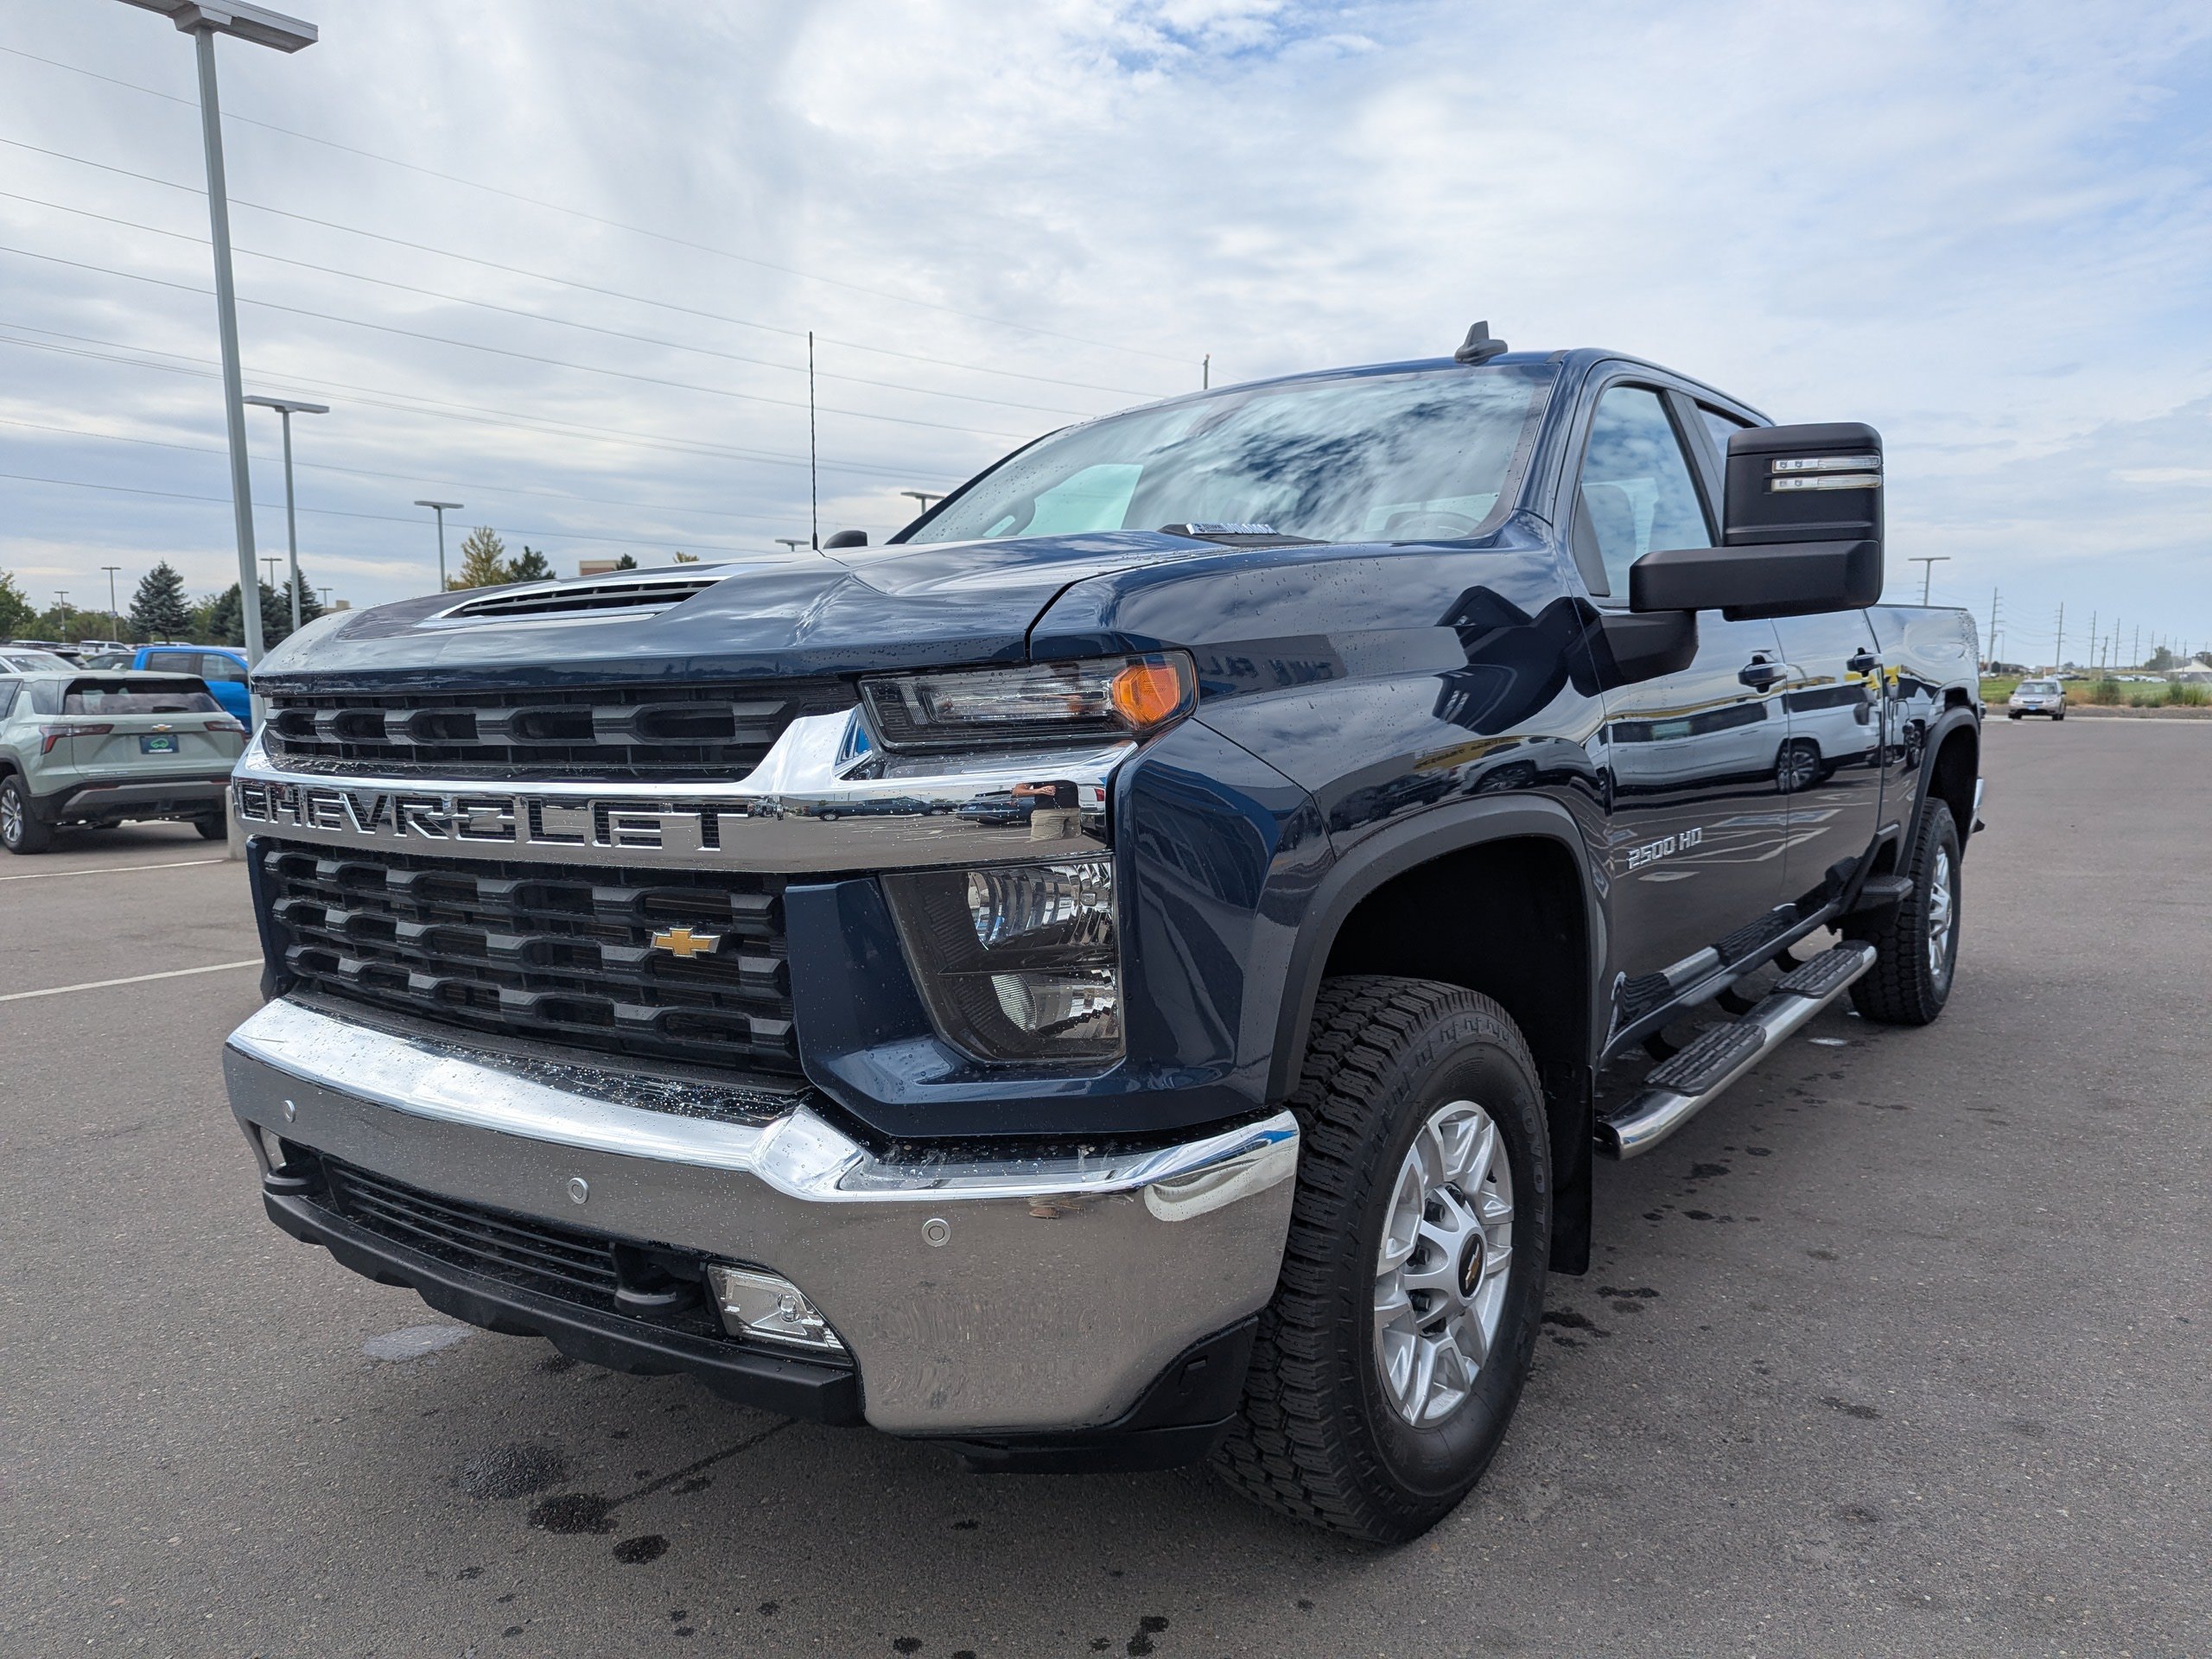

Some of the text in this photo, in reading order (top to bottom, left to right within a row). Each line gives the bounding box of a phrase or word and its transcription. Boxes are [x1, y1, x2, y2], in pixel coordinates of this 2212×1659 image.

[238, 783, 749, 851] CHEVROLET
[1628, 827, 1702, 869] 2500 HD
